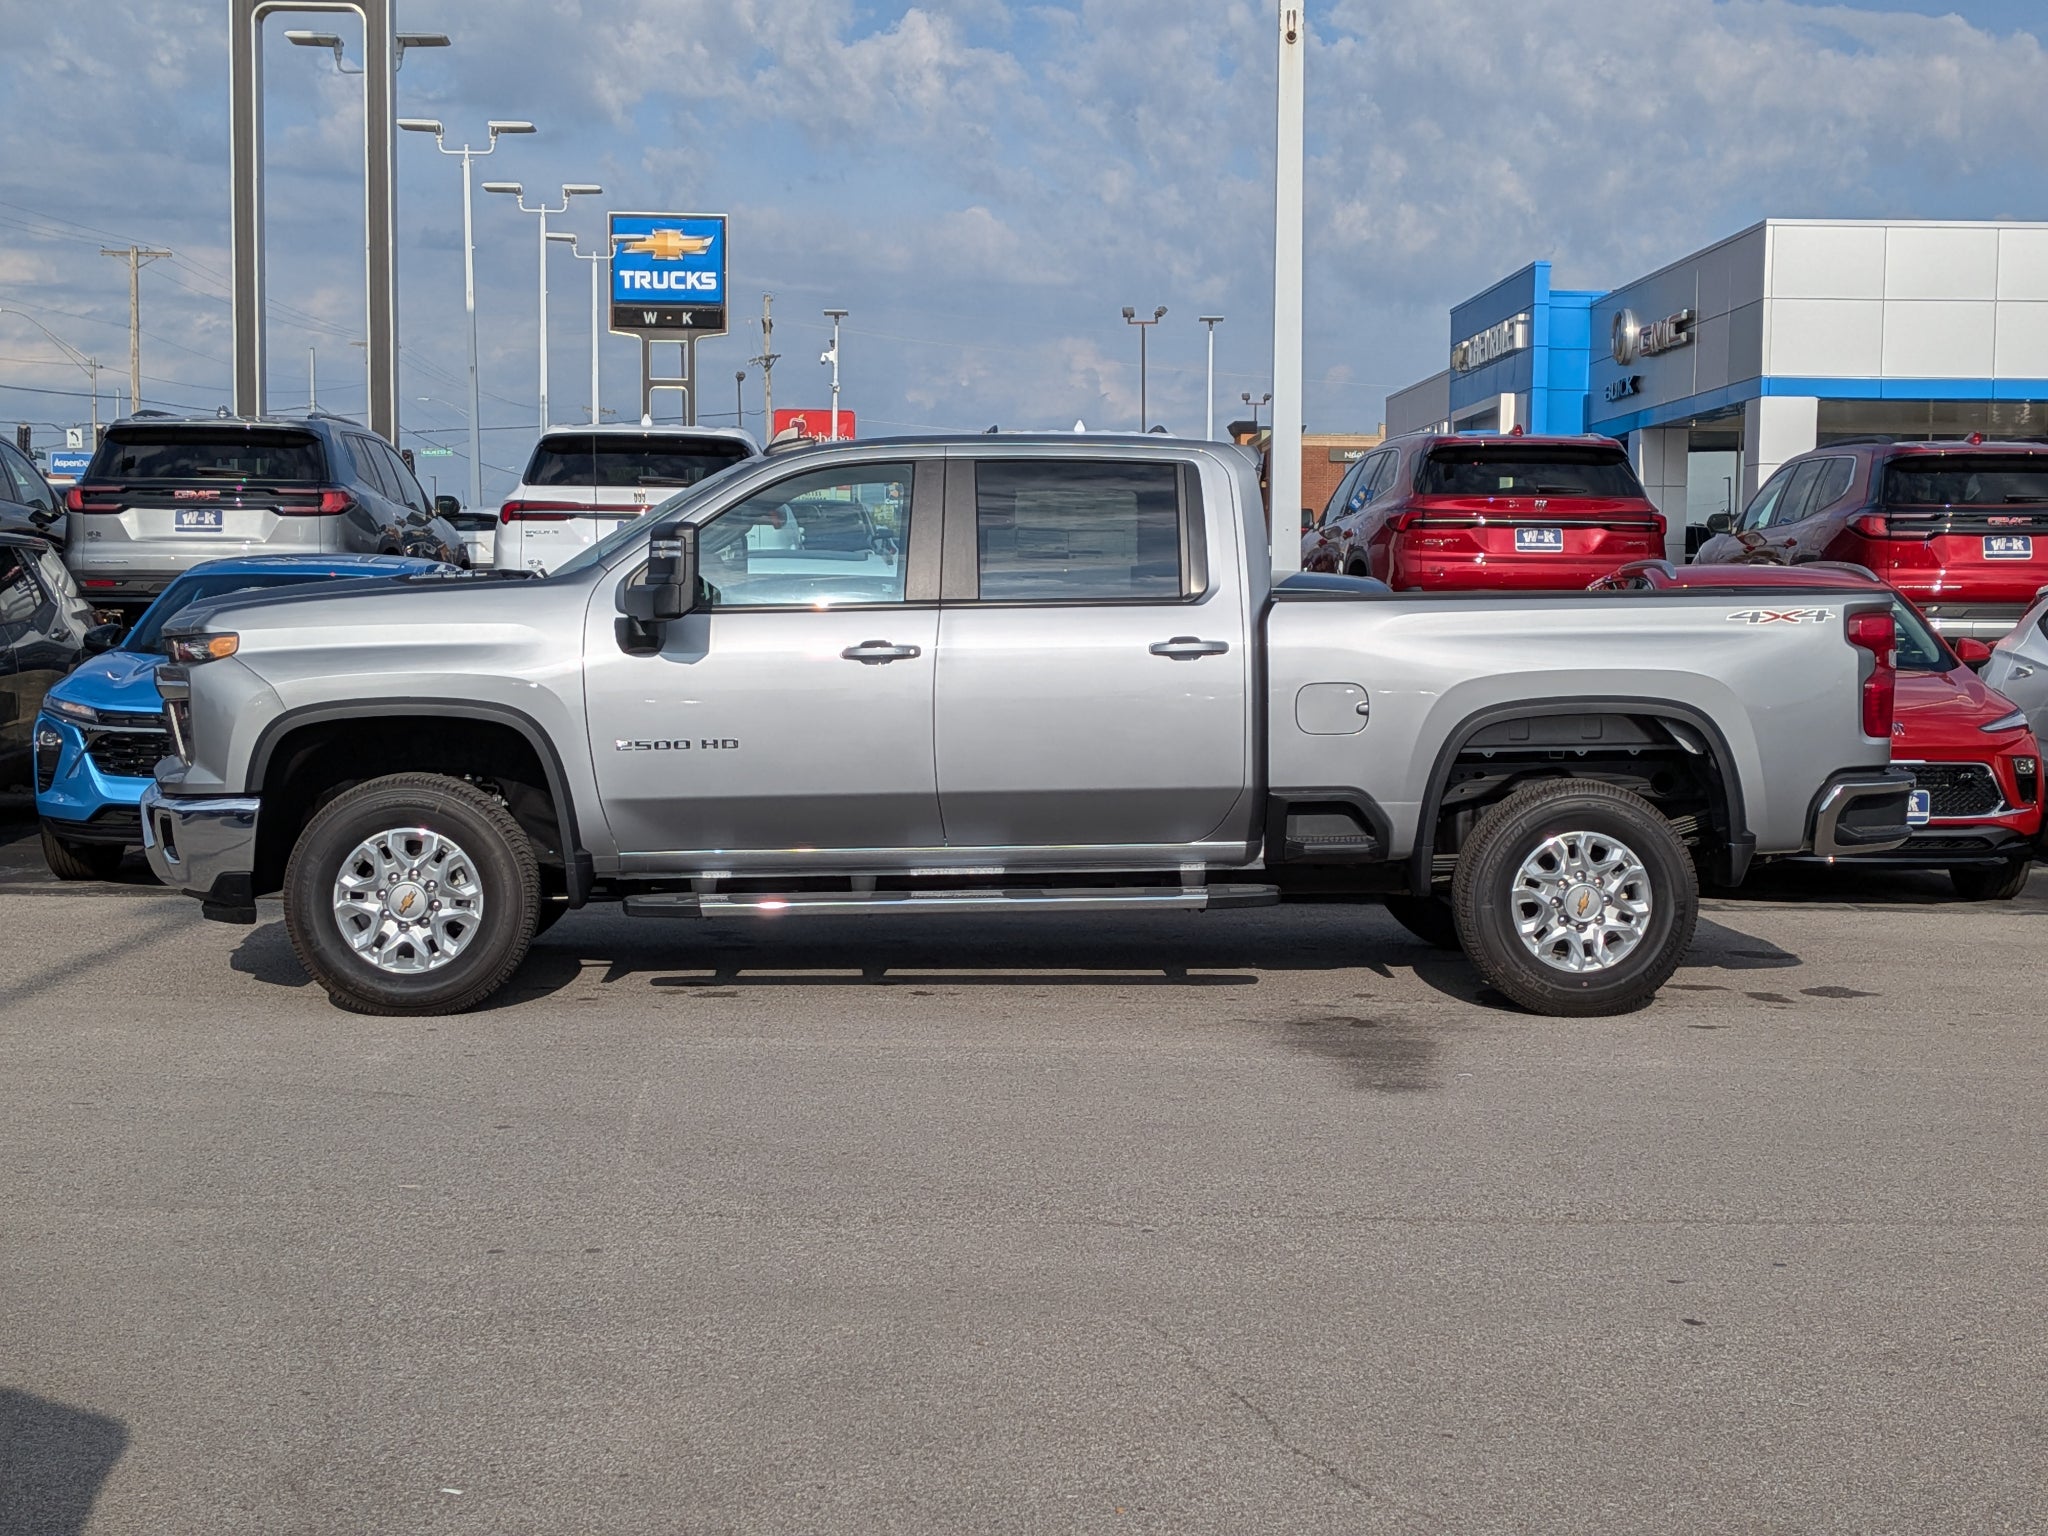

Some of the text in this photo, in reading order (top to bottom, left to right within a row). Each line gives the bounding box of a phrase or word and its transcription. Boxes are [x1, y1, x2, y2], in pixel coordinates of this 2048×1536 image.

[619, 270, 717, 290] TRUCKS
[1637, 309, 1688, 357] GMC
[1604, 375, 1635, 400] BUICK
[174, 490, 221, 500] GMC
[182, 511, 217, 525] W-K
[1523, 530, 1556, 543] W-K
[1991, 537, 2025, 551] W-K
[616, 739, 739, 751] 2500 HD
